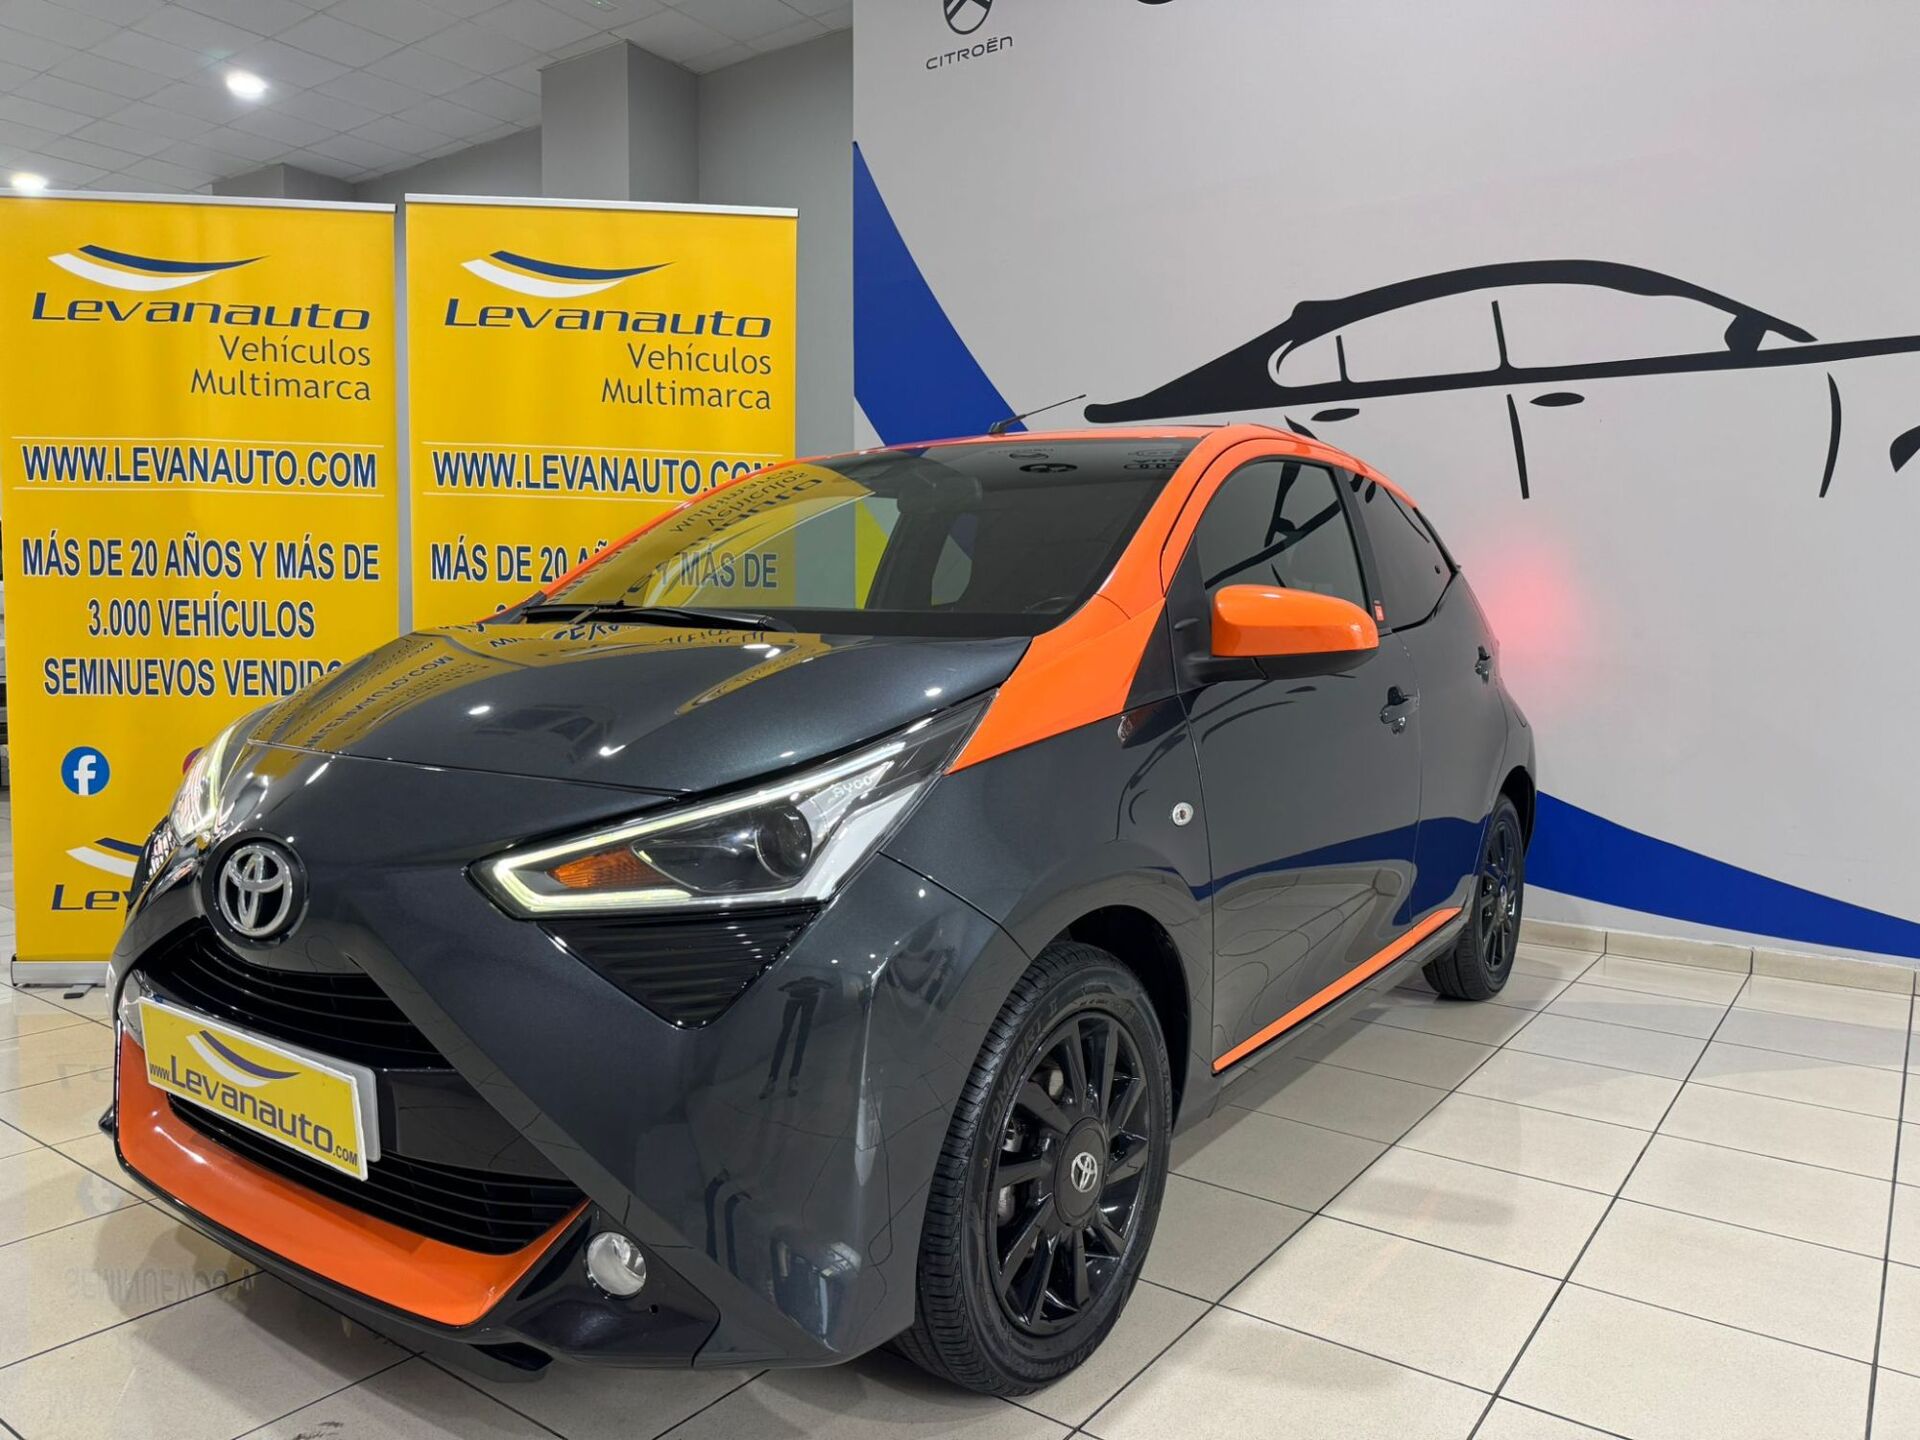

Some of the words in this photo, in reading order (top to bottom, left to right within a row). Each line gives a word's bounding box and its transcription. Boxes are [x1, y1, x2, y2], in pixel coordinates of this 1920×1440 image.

[926, 36, 1013, 70] CITROËN
[32, 292, 371, 330] Levanauto
[444, 298, 772, 338] Levanauto
[219, 334, 371, 366] Vehículos
[627, 342, 772, 375] Vehículos
[191, 368, 371, 401] Multimarca
[601, 377, 772, 410] Multimarca
[22, 445, 377, 488] WWW.LEVANAUTO.COM
[432, 450, 774, 494] WWW.LEVANAUTO.C
[22, 530, 80, 576] MÁS
[88, 540, 122, 576] DE
[131, 540, 157, 576] 20
[165, 532, 241, 578] AÑOS
[249, 542, 268, 578] Y
[276, 533, 335, 579] MÁS
[344, 544, 379, 580] DE
[431, 535, 487, 581] MÁS
[496, 545, 533, 582] DE
[540, 546, 567, 583] 20
[680, 543, 735, 588] MÁS
[744, 553, 777, 588] DE
[88, 598, 151, 636] 3.000
[159, 591, 314, 638] VEHÍCULOS
[44, 657, 215, 696] SEMINUEVOS
